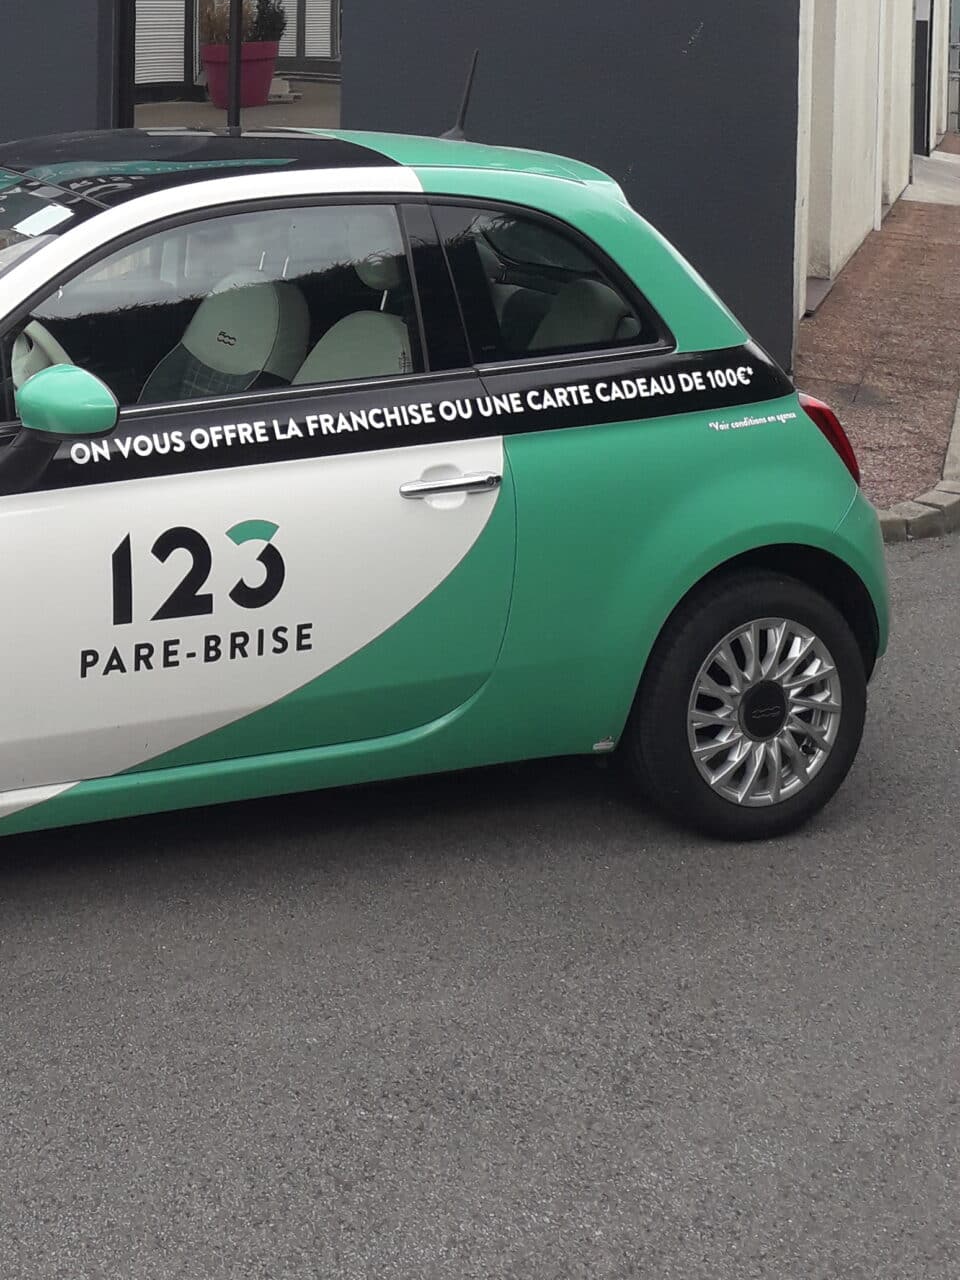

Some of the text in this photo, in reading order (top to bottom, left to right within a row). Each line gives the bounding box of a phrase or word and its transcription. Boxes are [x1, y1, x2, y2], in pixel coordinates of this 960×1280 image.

[70, 439, 111, 465] ON
[114, 431, 185, 459] VOUS
[190, 420, 269, 450] OFFRE
[272, 417, 304, 440] LA
[305, 402, 436, 437] FRANCHISE
[438, 398, 473, 421] OU
[476, 392, 525, 416] UNE
[526, 384, 594, 411] CARTE
[595, 375, 676, 404] CADEAU
[679, 372, 706, 392] DE
[730, 415, 767, 429] conditions
[111, 518, 286, 626] 123
[80, 622, 313, 679] PARE-BRISE
